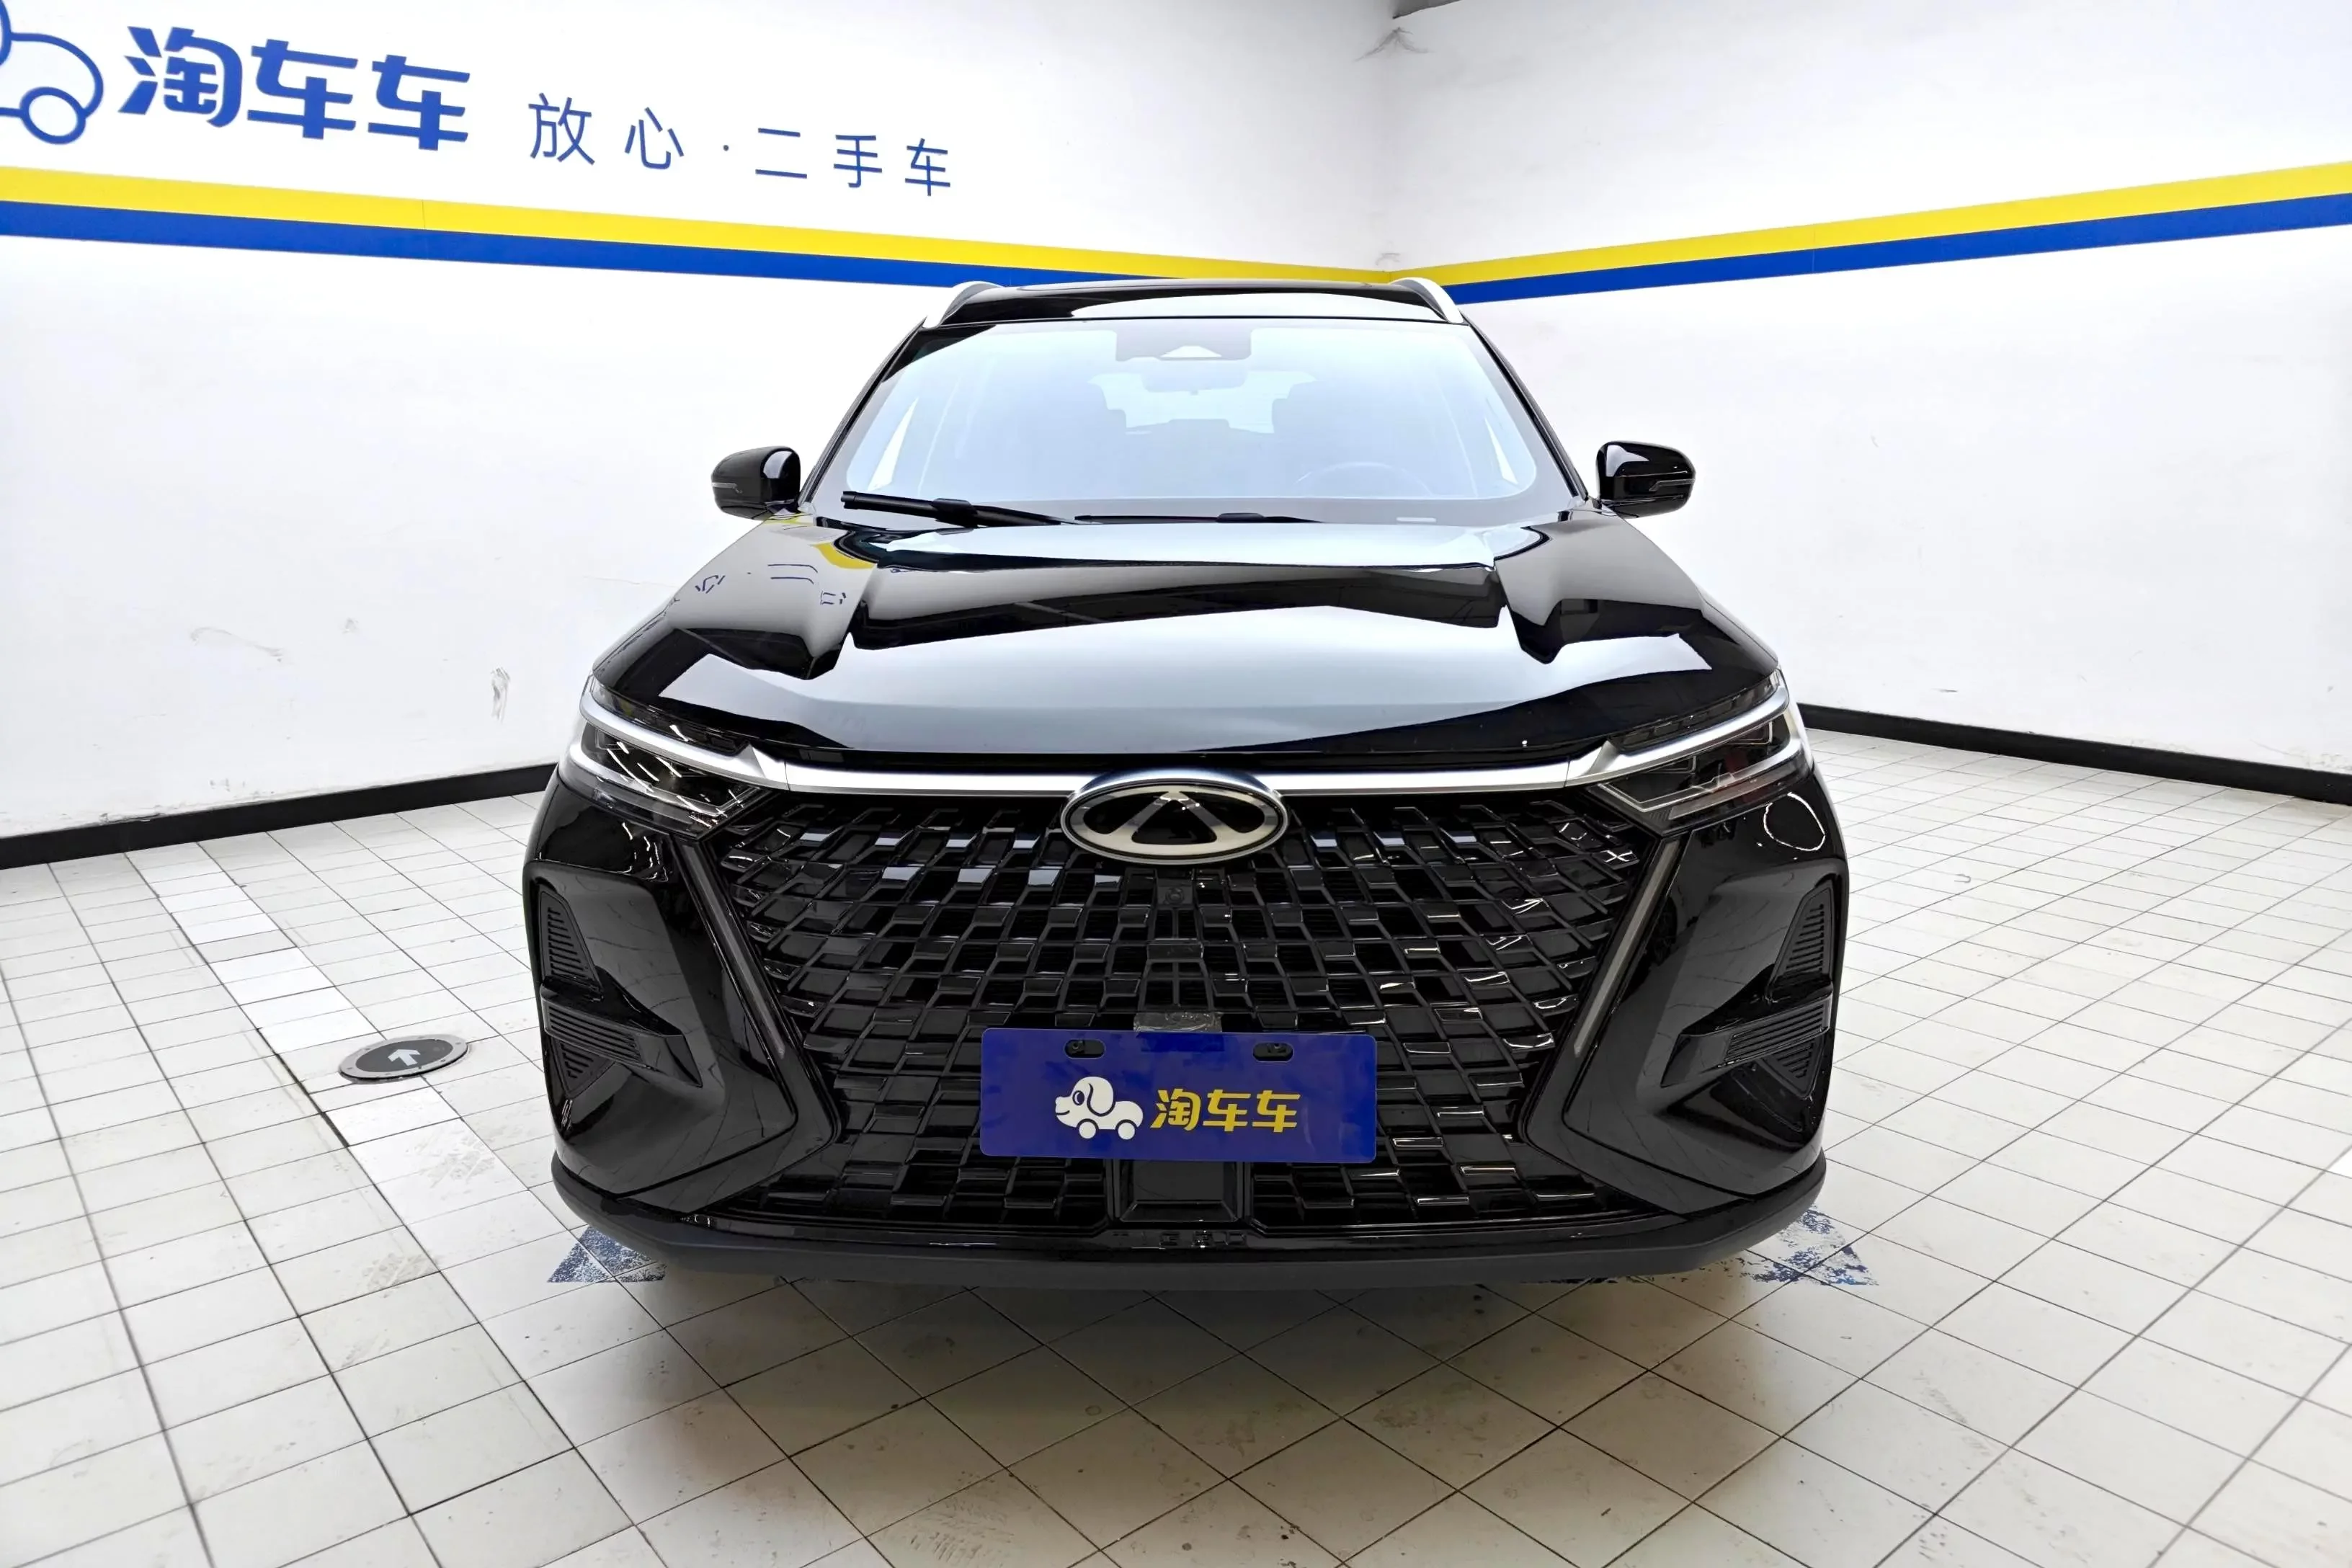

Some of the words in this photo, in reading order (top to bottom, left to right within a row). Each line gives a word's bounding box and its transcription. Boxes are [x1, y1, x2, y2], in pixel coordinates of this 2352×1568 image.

[118, 26, 471, 151] 淘车车
[1150, 1088, 1301, 1133] 淘车车
